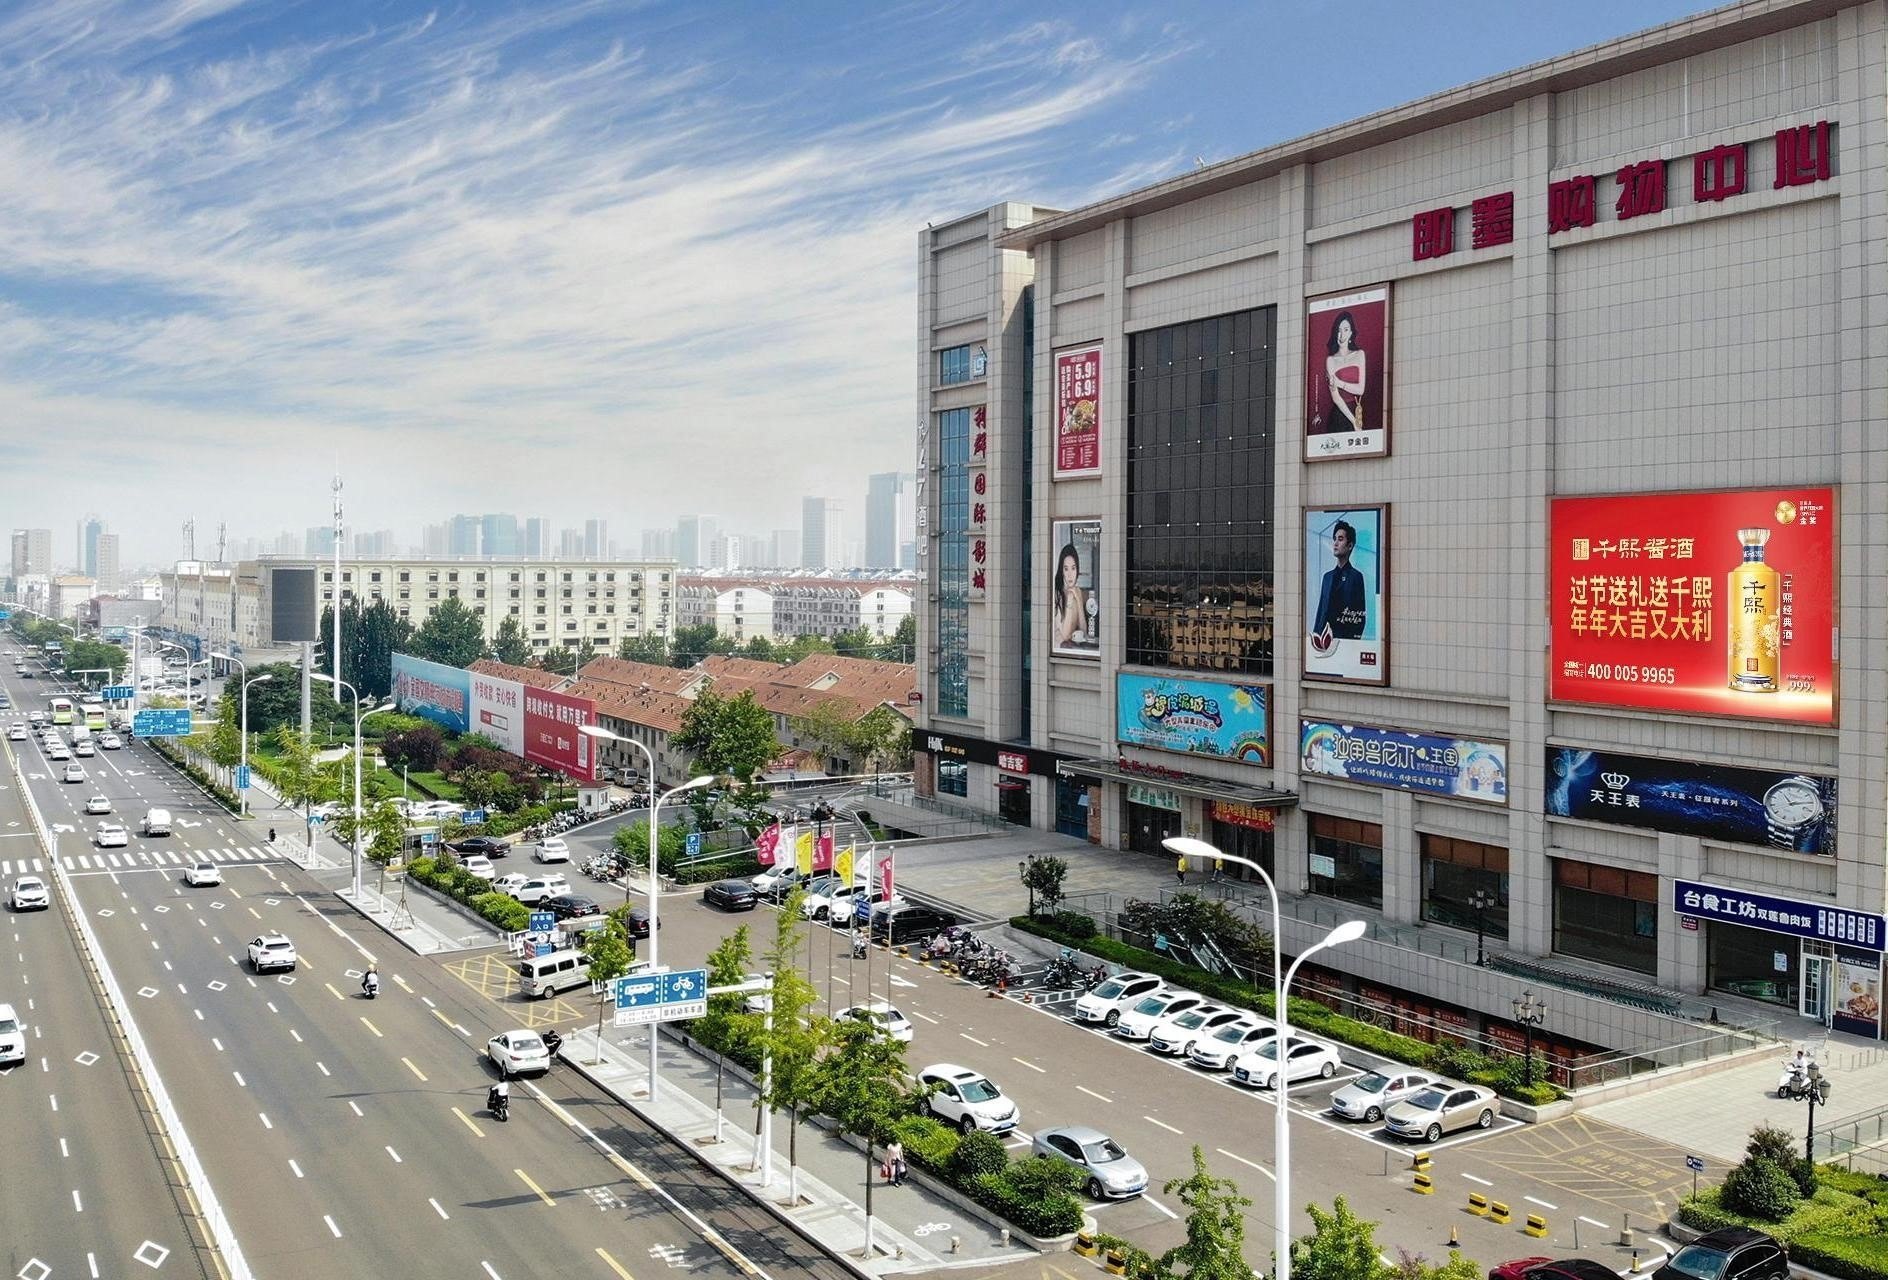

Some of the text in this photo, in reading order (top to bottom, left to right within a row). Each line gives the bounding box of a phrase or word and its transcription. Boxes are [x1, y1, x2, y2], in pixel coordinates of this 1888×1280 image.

[1413, 121, 1832, 261] 即墨购物中心
[1074, 362, 1092, 380] 5.9
[1074, 380, 1092, 398] 6.9
[1592, 537, 1695, 560] 千熙酱酒
[1570, 575, 1713, 608] 过节送礼送千熙
[1743, 581, 1766, 614] 千熙
[1570, 606, 1713, 642] 年年大吉又大利
[1588, 663, 1612, 680] 400
[1614, 665, 1639, 682] 005
[1641, 666, 1675, 684] 9965
[1590, 788, 1641, 808] 天王表
[690, 836, 696, 844] P
[1684, 890, 1757, 919] 台食工坊
